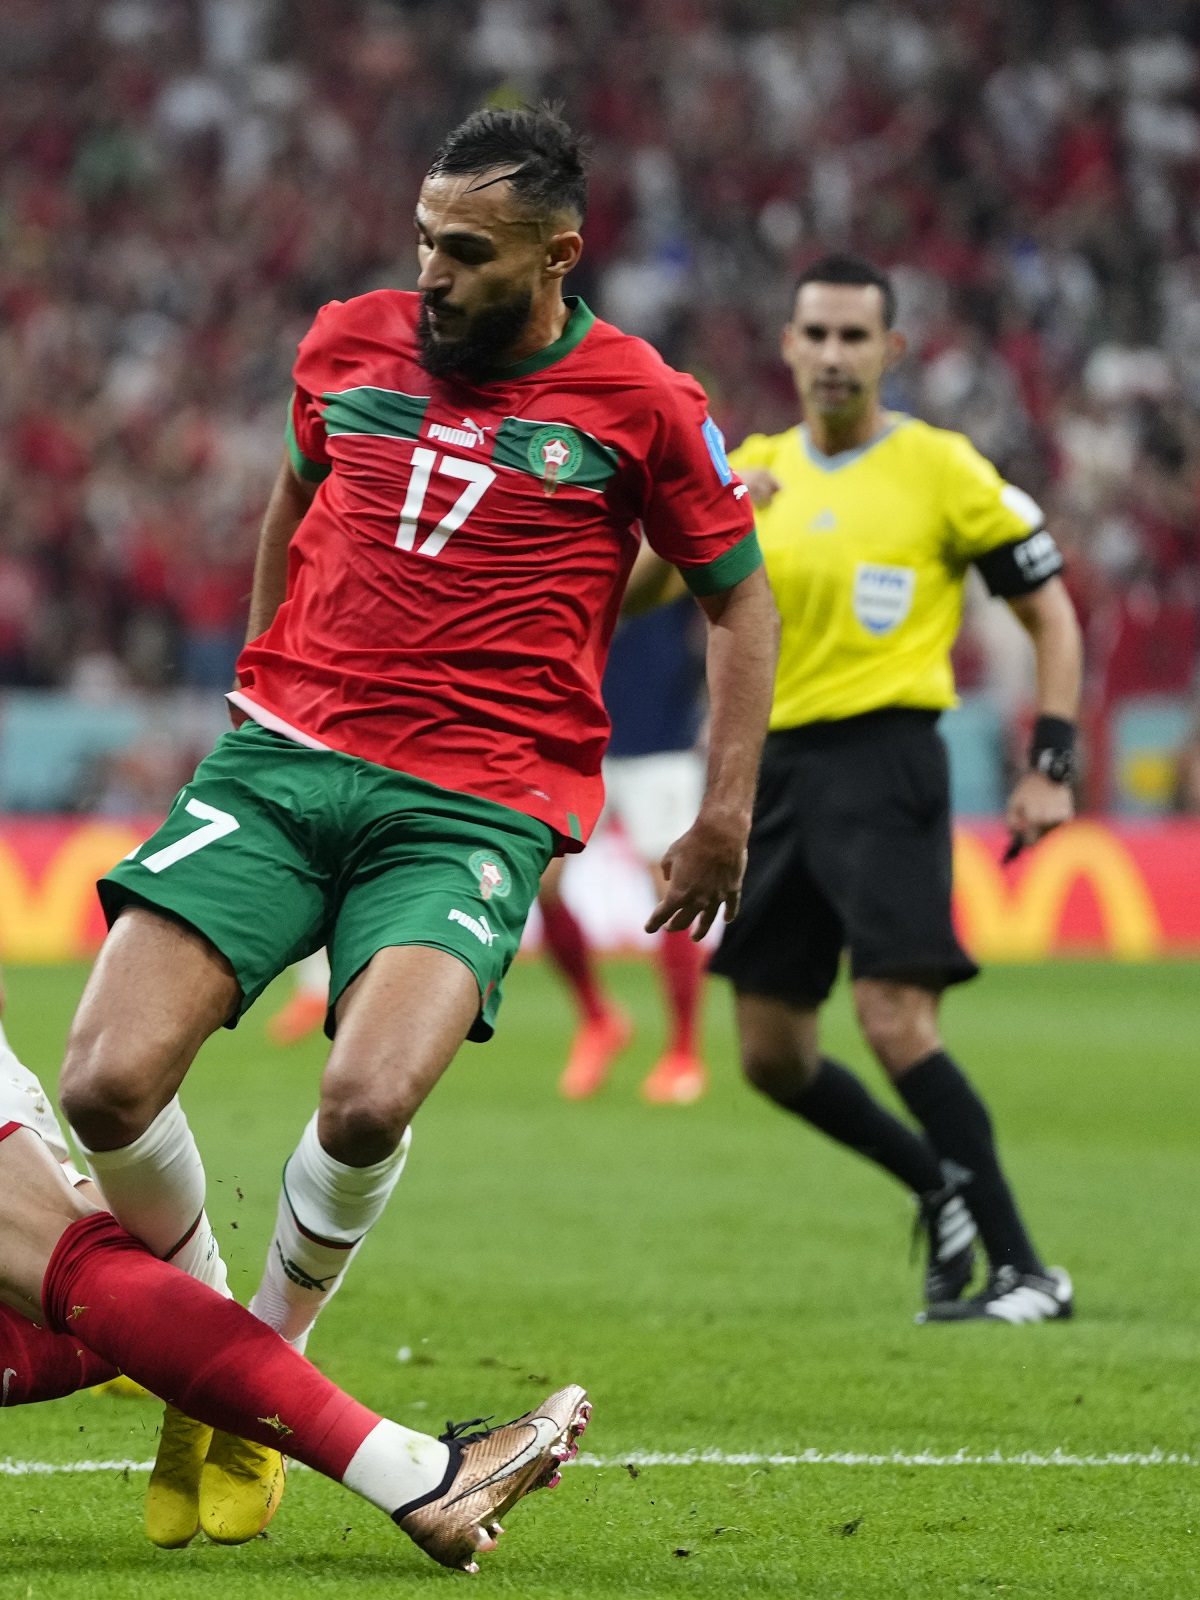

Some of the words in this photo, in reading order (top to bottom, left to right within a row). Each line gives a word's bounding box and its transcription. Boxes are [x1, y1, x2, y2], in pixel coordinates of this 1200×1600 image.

[427, 423, 478, 448] PUMA
[394, 446, 497, 557] 17
[124, 790, 241, 874] 7
[447, 908, 488, 944] PUMA
